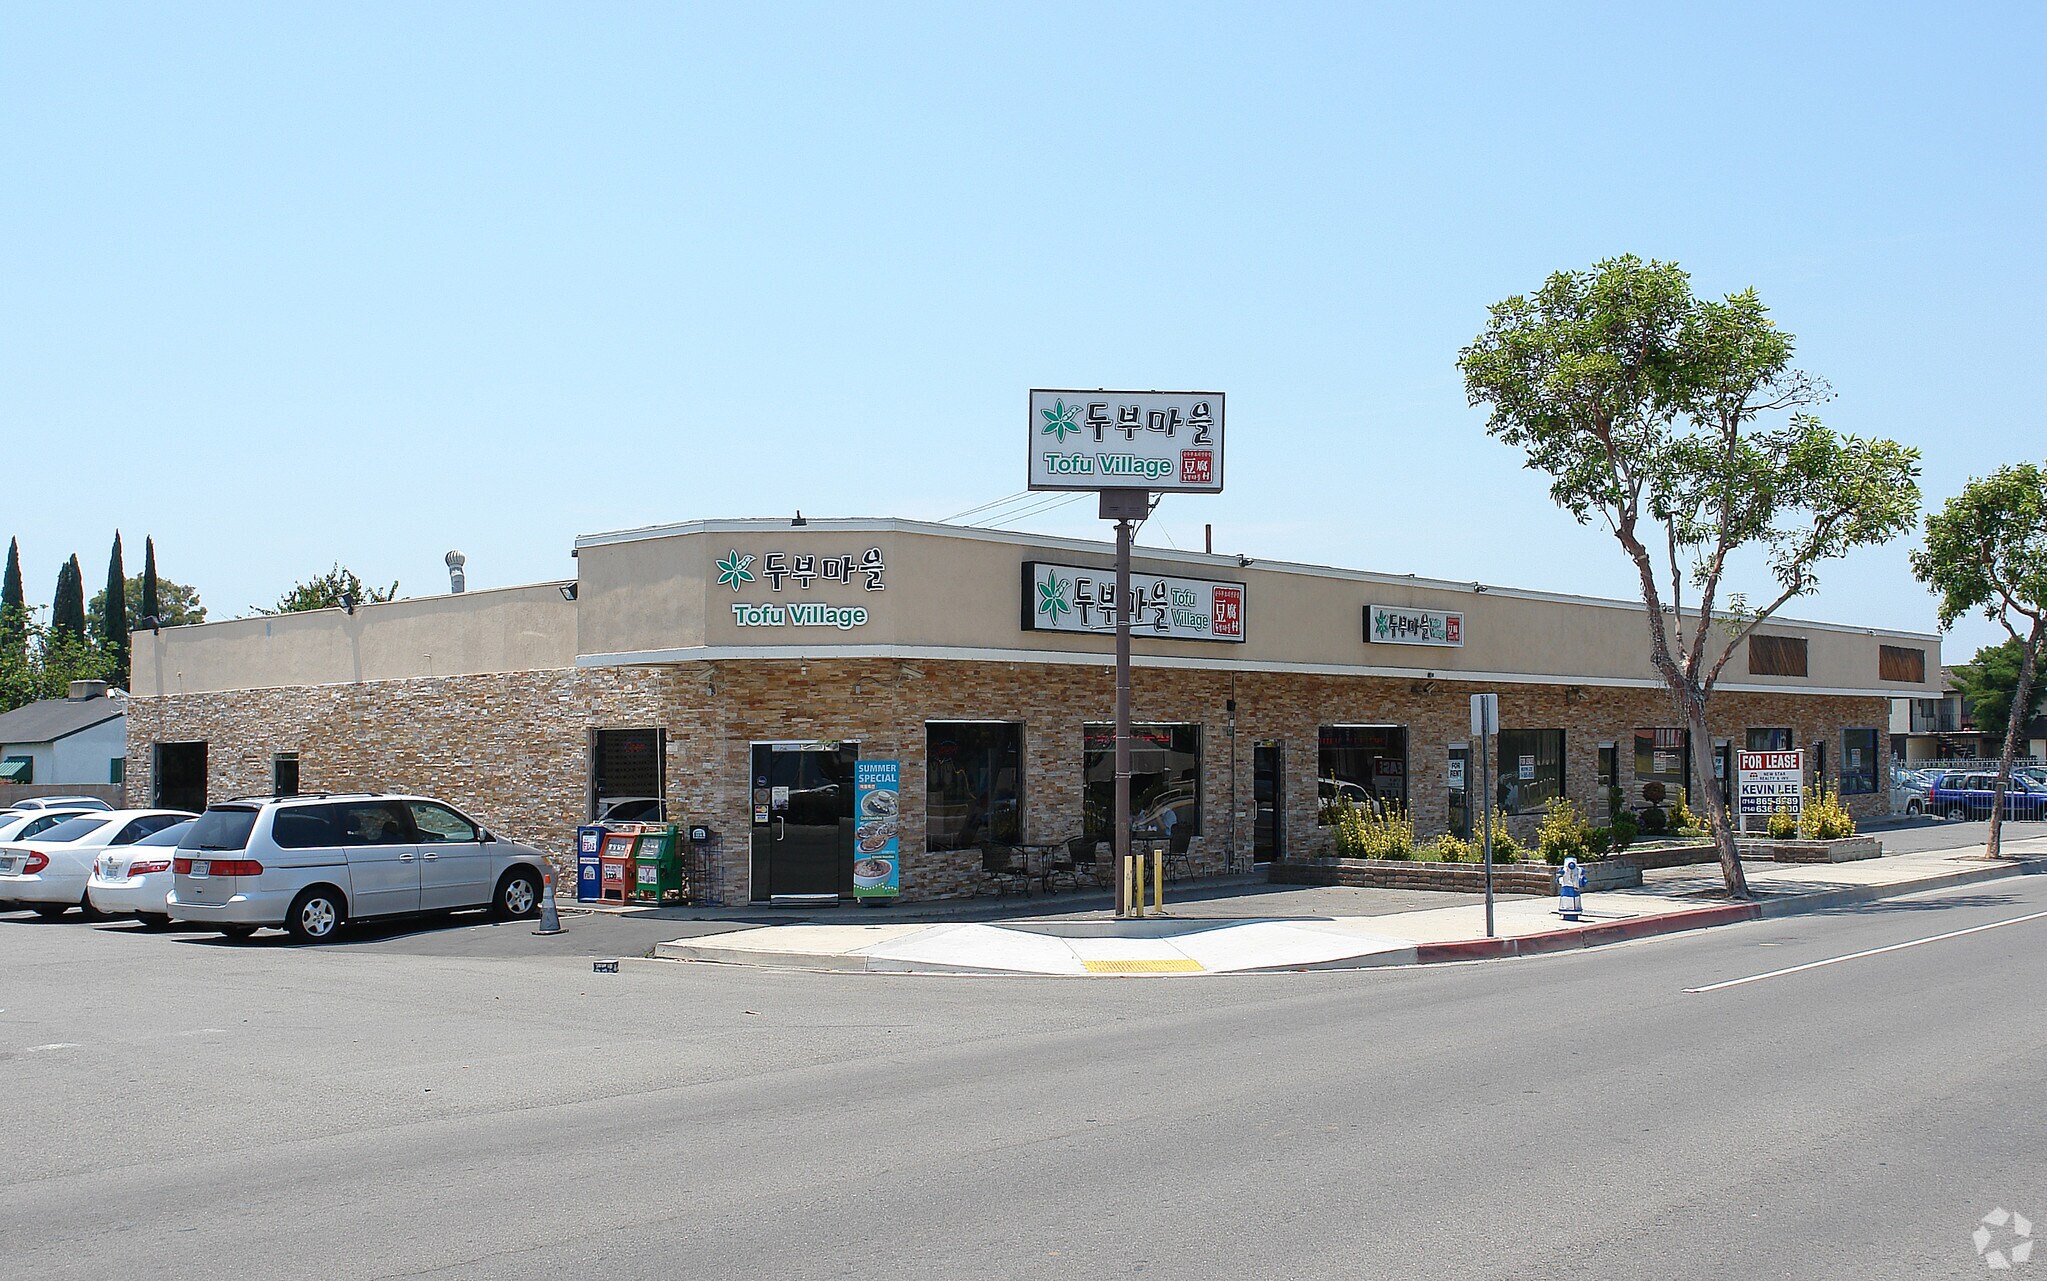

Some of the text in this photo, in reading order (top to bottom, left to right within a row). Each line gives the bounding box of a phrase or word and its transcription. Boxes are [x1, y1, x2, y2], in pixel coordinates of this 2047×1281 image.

[1085, 401, 1214, 446] 두부마을
[1045, 453, 1173, 478] Tofu Village
[763, 548, 885, 592] 두부마을
[1171, 589, 1196, 608] Tofu
[732, 604, 868, 629] Tofu Village
[1171, 609, 1209, 628] Village
[858, 764, 897, 773] SUMMER
[1742, 755, 1797, 769] FOR LEASE
[858, 774, 897, 783] SPECIAL
[1742, 784, 1798, 795] KEVIN LEE
[1756, 805, 1798, 813] 636-600
